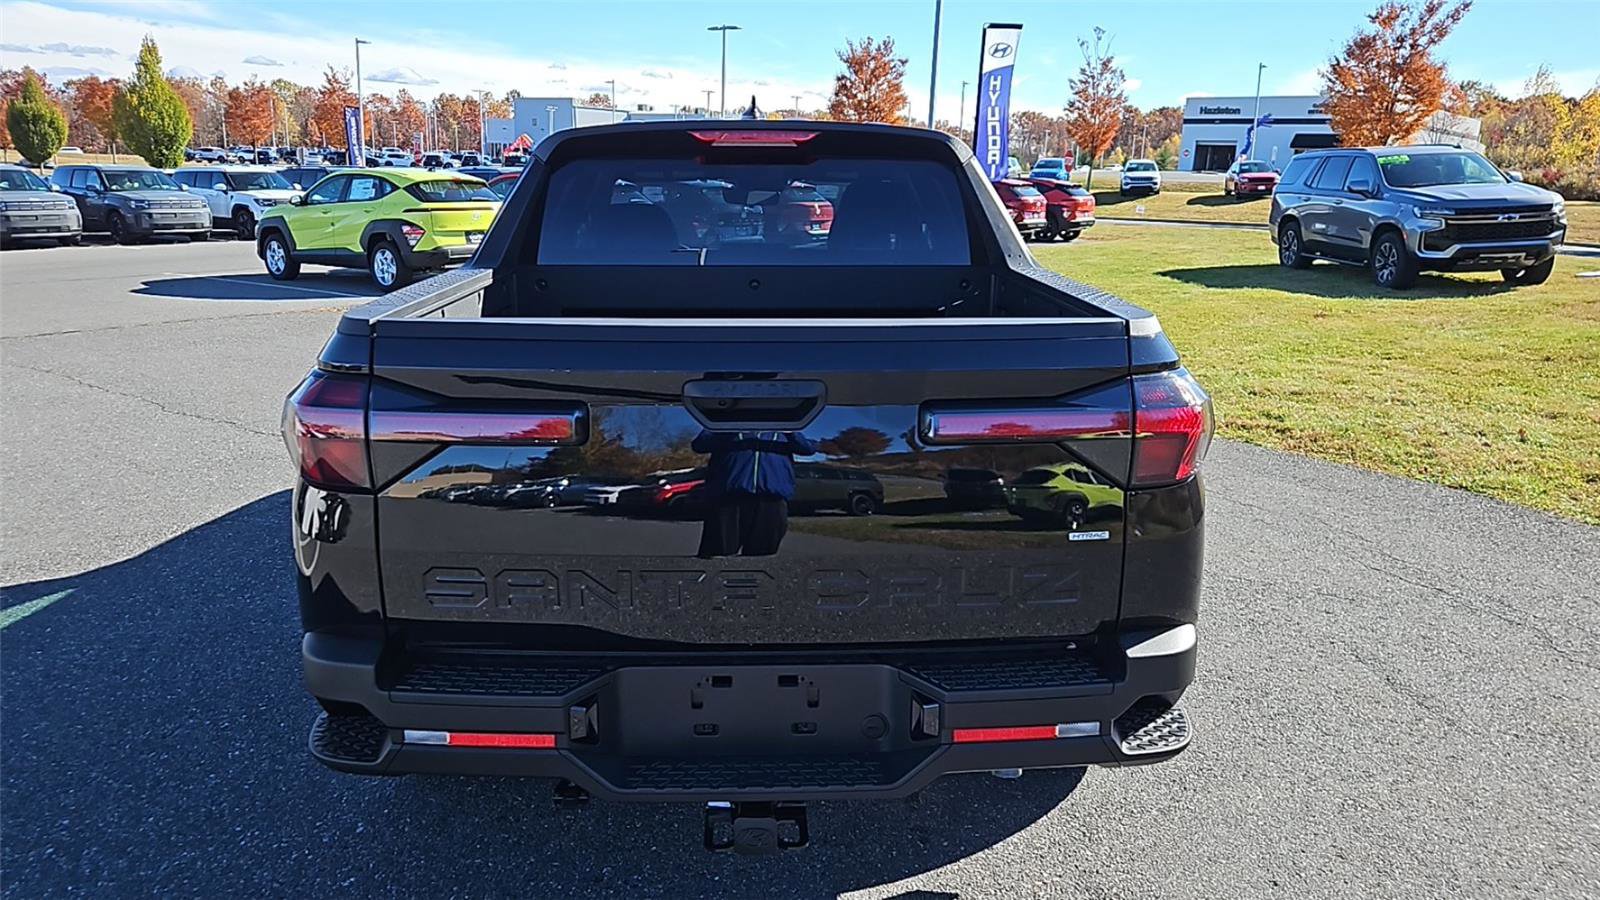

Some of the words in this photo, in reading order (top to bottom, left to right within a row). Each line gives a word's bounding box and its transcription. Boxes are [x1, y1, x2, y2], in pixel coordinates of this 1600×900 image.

[1200, 106, 1241, 115] Hazleton
[987, 75, 1001, 179] HYUNDAI
[1072, 532, 1107, 540] HTRAC
[422, 566, 777, 611] SANTA
[806, 564, 1081, 610] CRUZ
